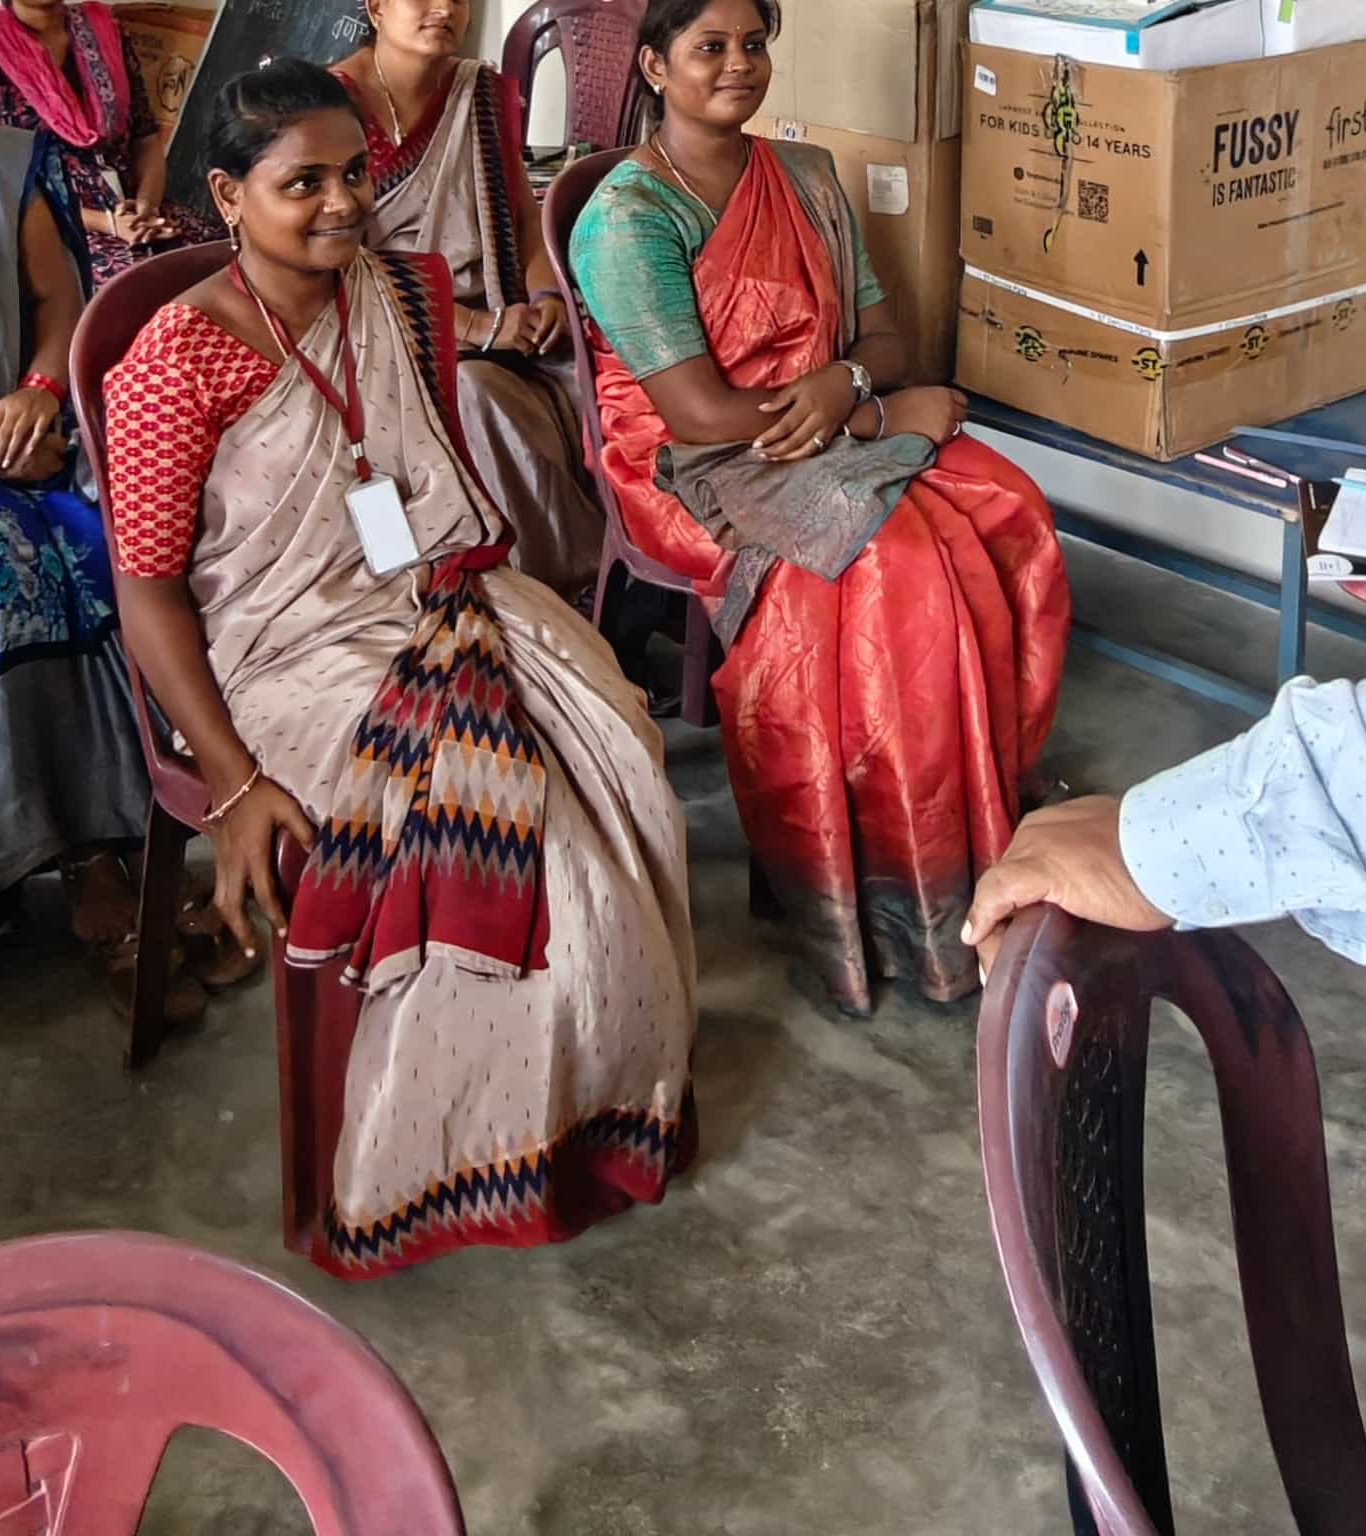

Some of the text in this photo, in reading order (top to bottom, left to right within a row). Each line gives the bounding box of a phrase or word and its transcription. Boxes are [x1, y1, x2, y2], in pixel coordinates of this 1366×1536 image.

[979, 113, 1006, 130] FOR
[1008, 120, 1040, 138] KIDS
[1086, 135, 1100, 148] 14
[1104, 140, 1151, 159] YEARS
[1212, 109, 1300, 174] FUSSY
[1211, 167, 1296, 207] IS FANTASTIC
[1247, 335, 1261, 351] ST
[1140, 357, 1159, 371] ST
